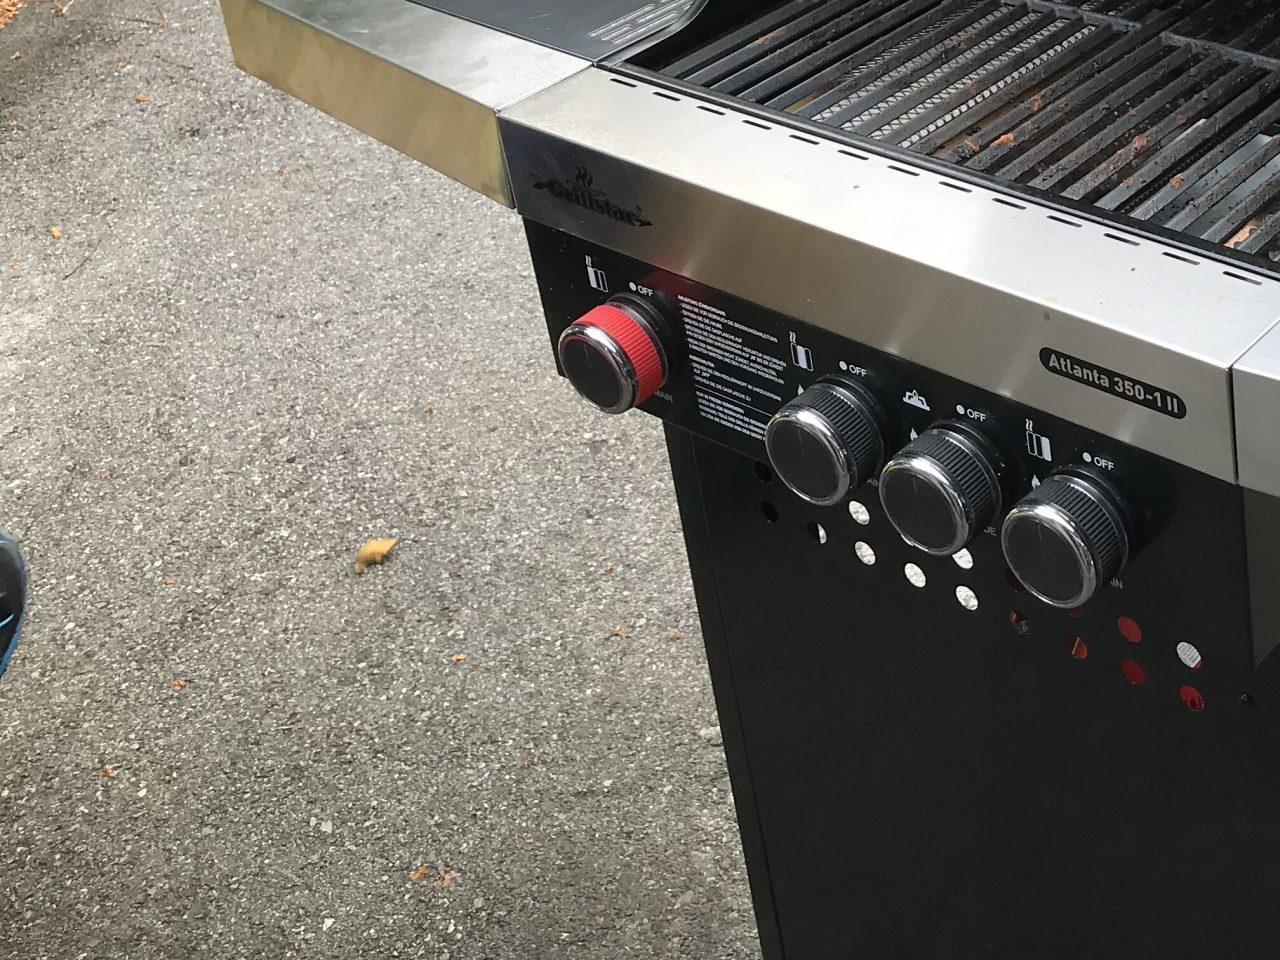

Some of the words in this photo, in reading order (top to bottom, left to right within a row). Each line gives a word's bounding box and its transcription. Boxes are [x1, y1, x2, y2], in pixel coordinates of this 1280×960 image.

[637, 285, 653, 297] OFF
[849, 364, 867, 377] OFF
[1048, 353, 1110, 388] Atlanta
[1114, 376, 1162, 408] 350-1
[966, 408, 986, 422] OFF
[1093, 456, 1115, 471] OFF
